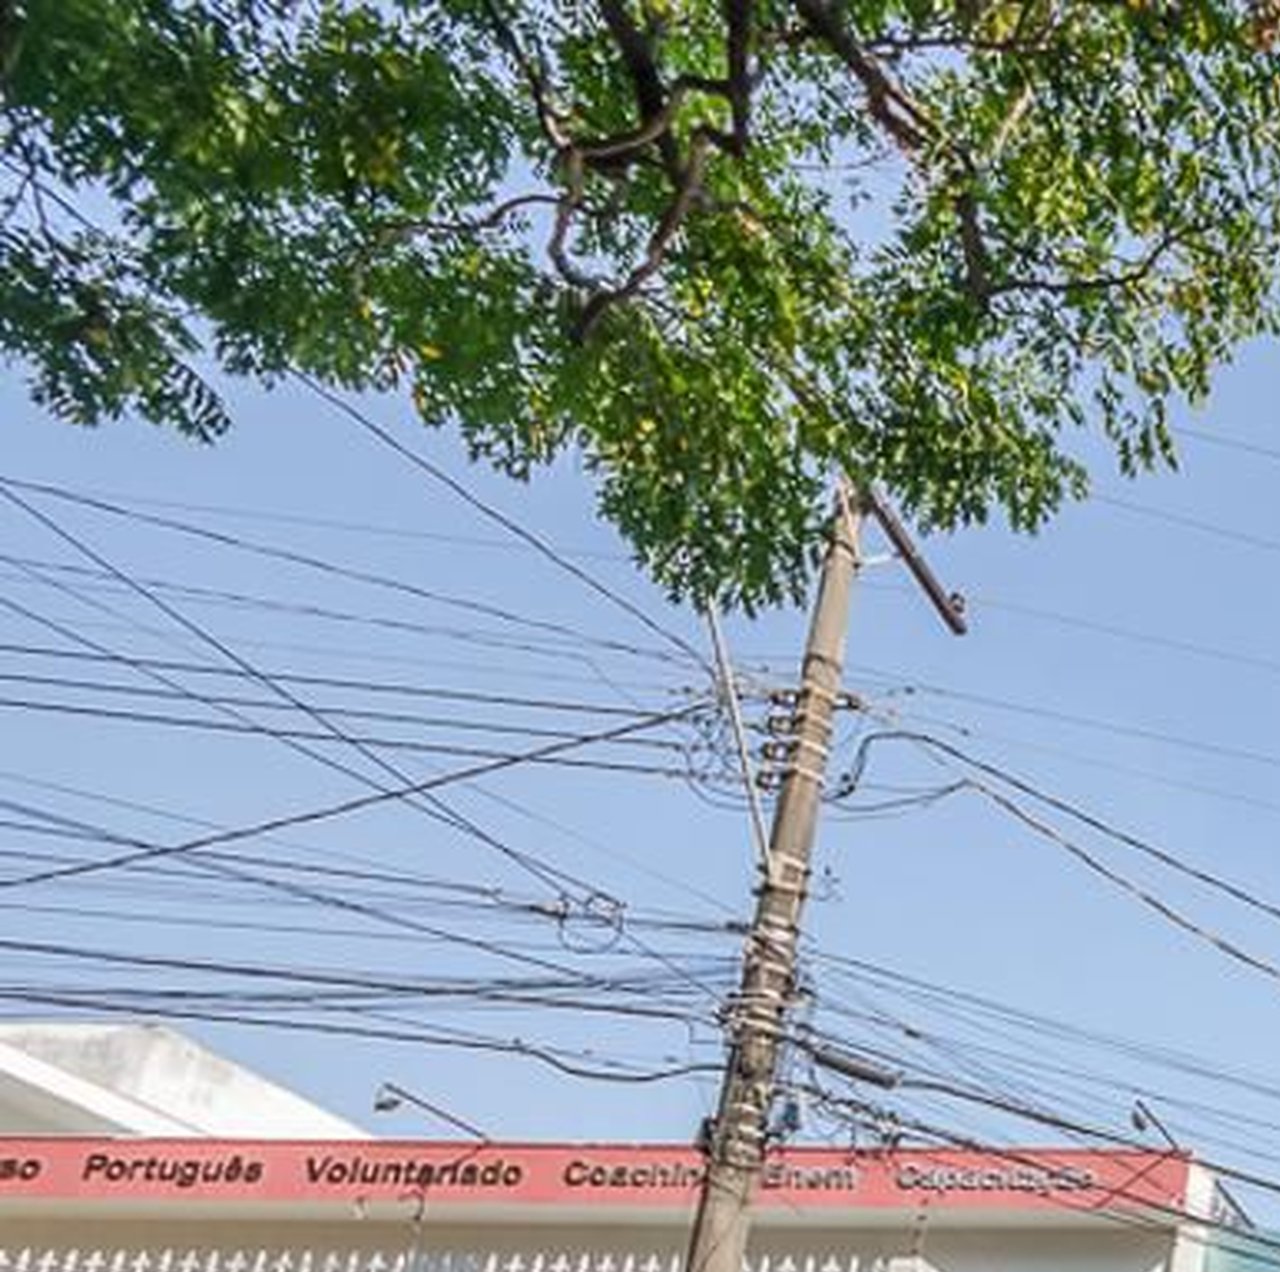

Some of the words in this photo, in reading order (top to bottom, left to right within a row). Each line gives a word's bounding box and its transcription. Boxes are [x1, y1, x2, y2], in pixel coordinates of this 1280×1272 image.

[82, 1154, 263, 1187] Português
[306, 1156, 523, 1186] Voluntariado
[563, 1161, 707, 1188] Coachin
